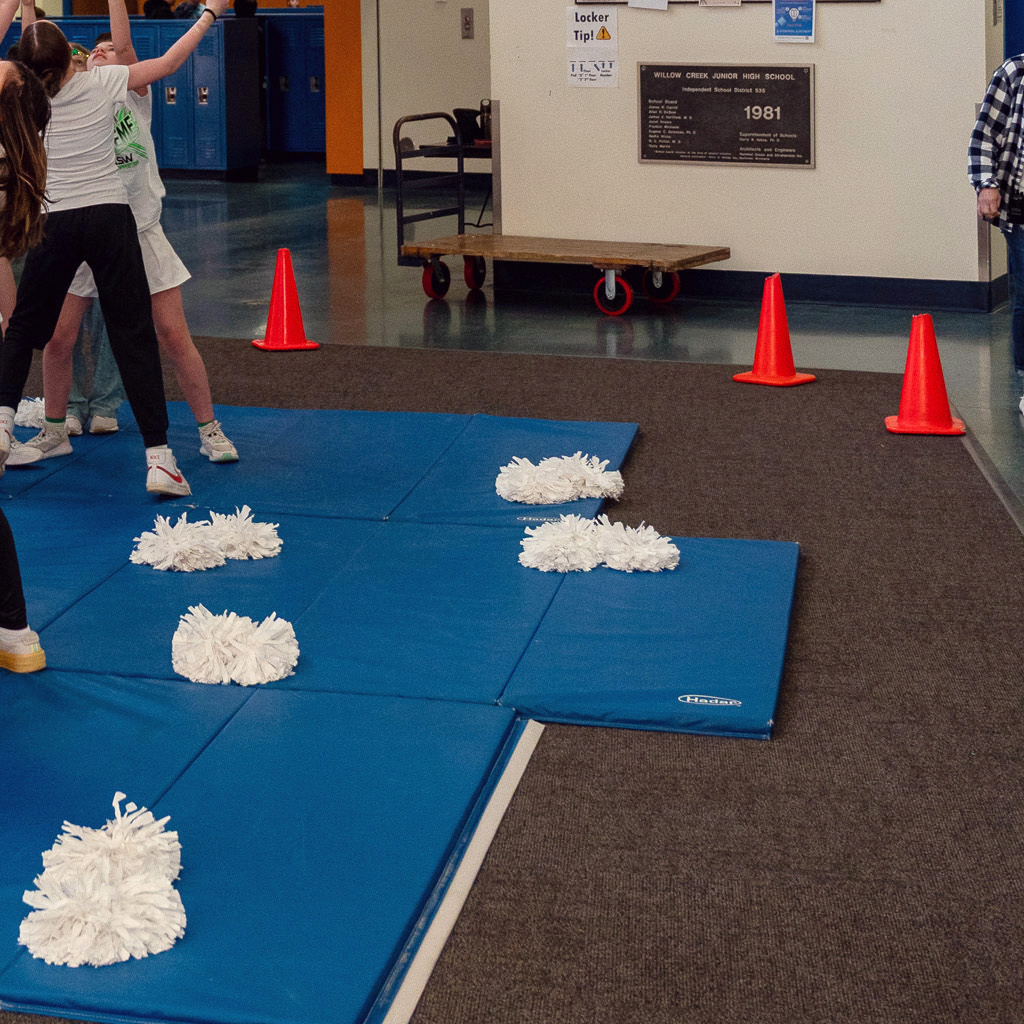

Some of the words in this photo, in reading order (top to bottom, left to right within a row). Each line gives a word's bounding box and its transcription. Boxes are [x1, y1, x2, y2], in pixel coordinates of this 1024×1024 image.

[574, 11, 609, 23] Locker
[573, 29, 594, 43] Tip!
[653, 71, 682, 79] WILLOW
[712, 72, 738, 80] JUNIOR
[765, 73, 796, 81] SCHOOL
[744, 105, 781, 120] 1981
[686, 696, 739, 705] Hadar
